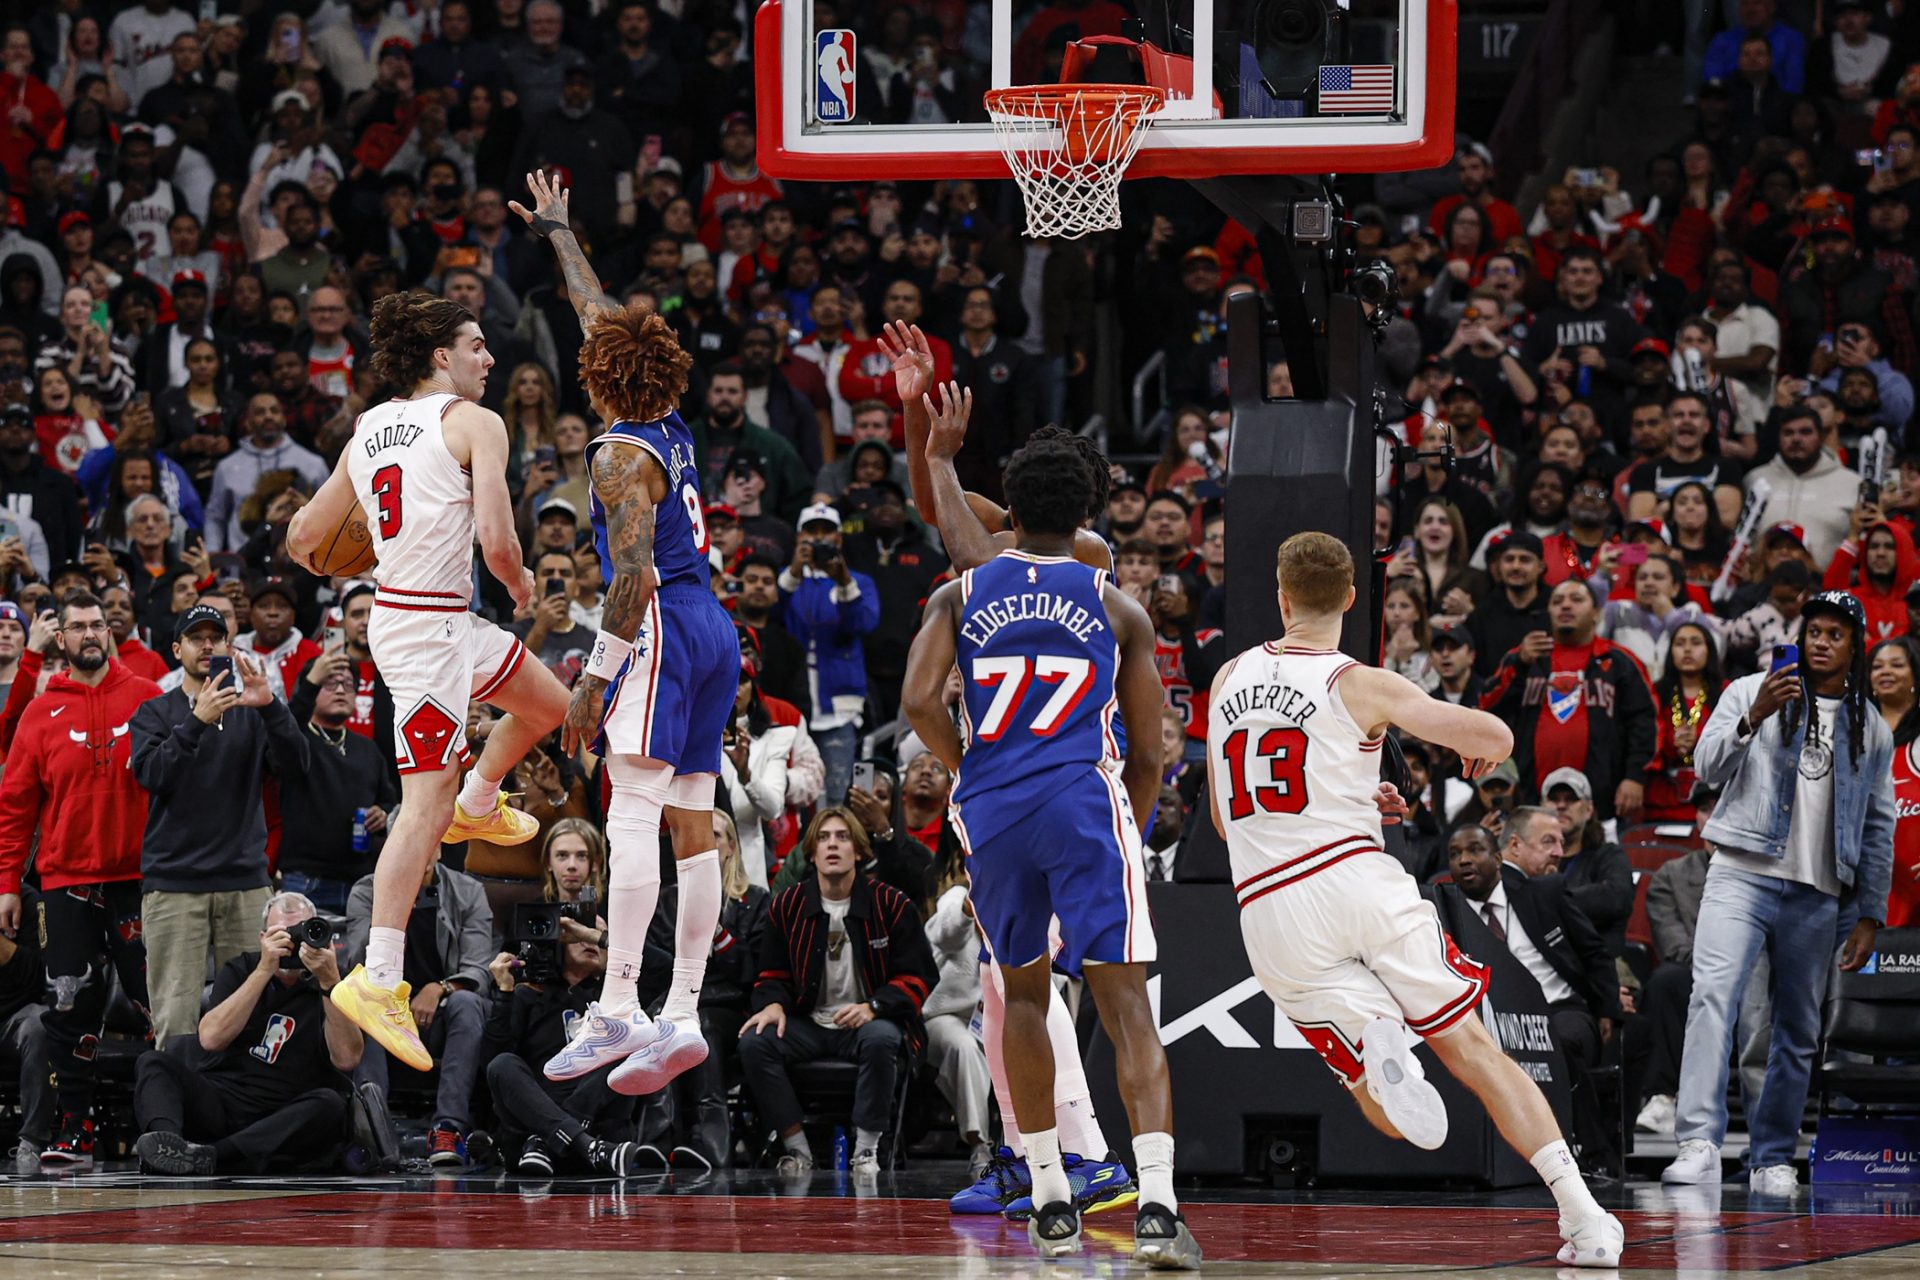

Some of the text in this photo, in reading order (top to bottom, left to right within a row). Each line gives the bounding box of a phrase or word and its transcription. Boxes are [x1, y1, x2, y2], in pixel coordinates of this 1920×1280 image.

[1482, 23, 1519, 58] 117
[821, 101, 841, 117] NBA
[365, 424, 424, 458] GIDDEY
[371, 462, 403, 541] 3
[682, 483, 710, 555] 9
[961, 592, 1105, 648] EDGECOMBE
[597, 641, 606, 655] 9
[972, 655, 1097, 743] 77
[1220, 684, 1317, 727] HUERTER
[1222, 727, 1309, 821] 13
[1880, 953, 1896, 966] LA
[1495, 1012, 1555, 1051] WIND CREEK
